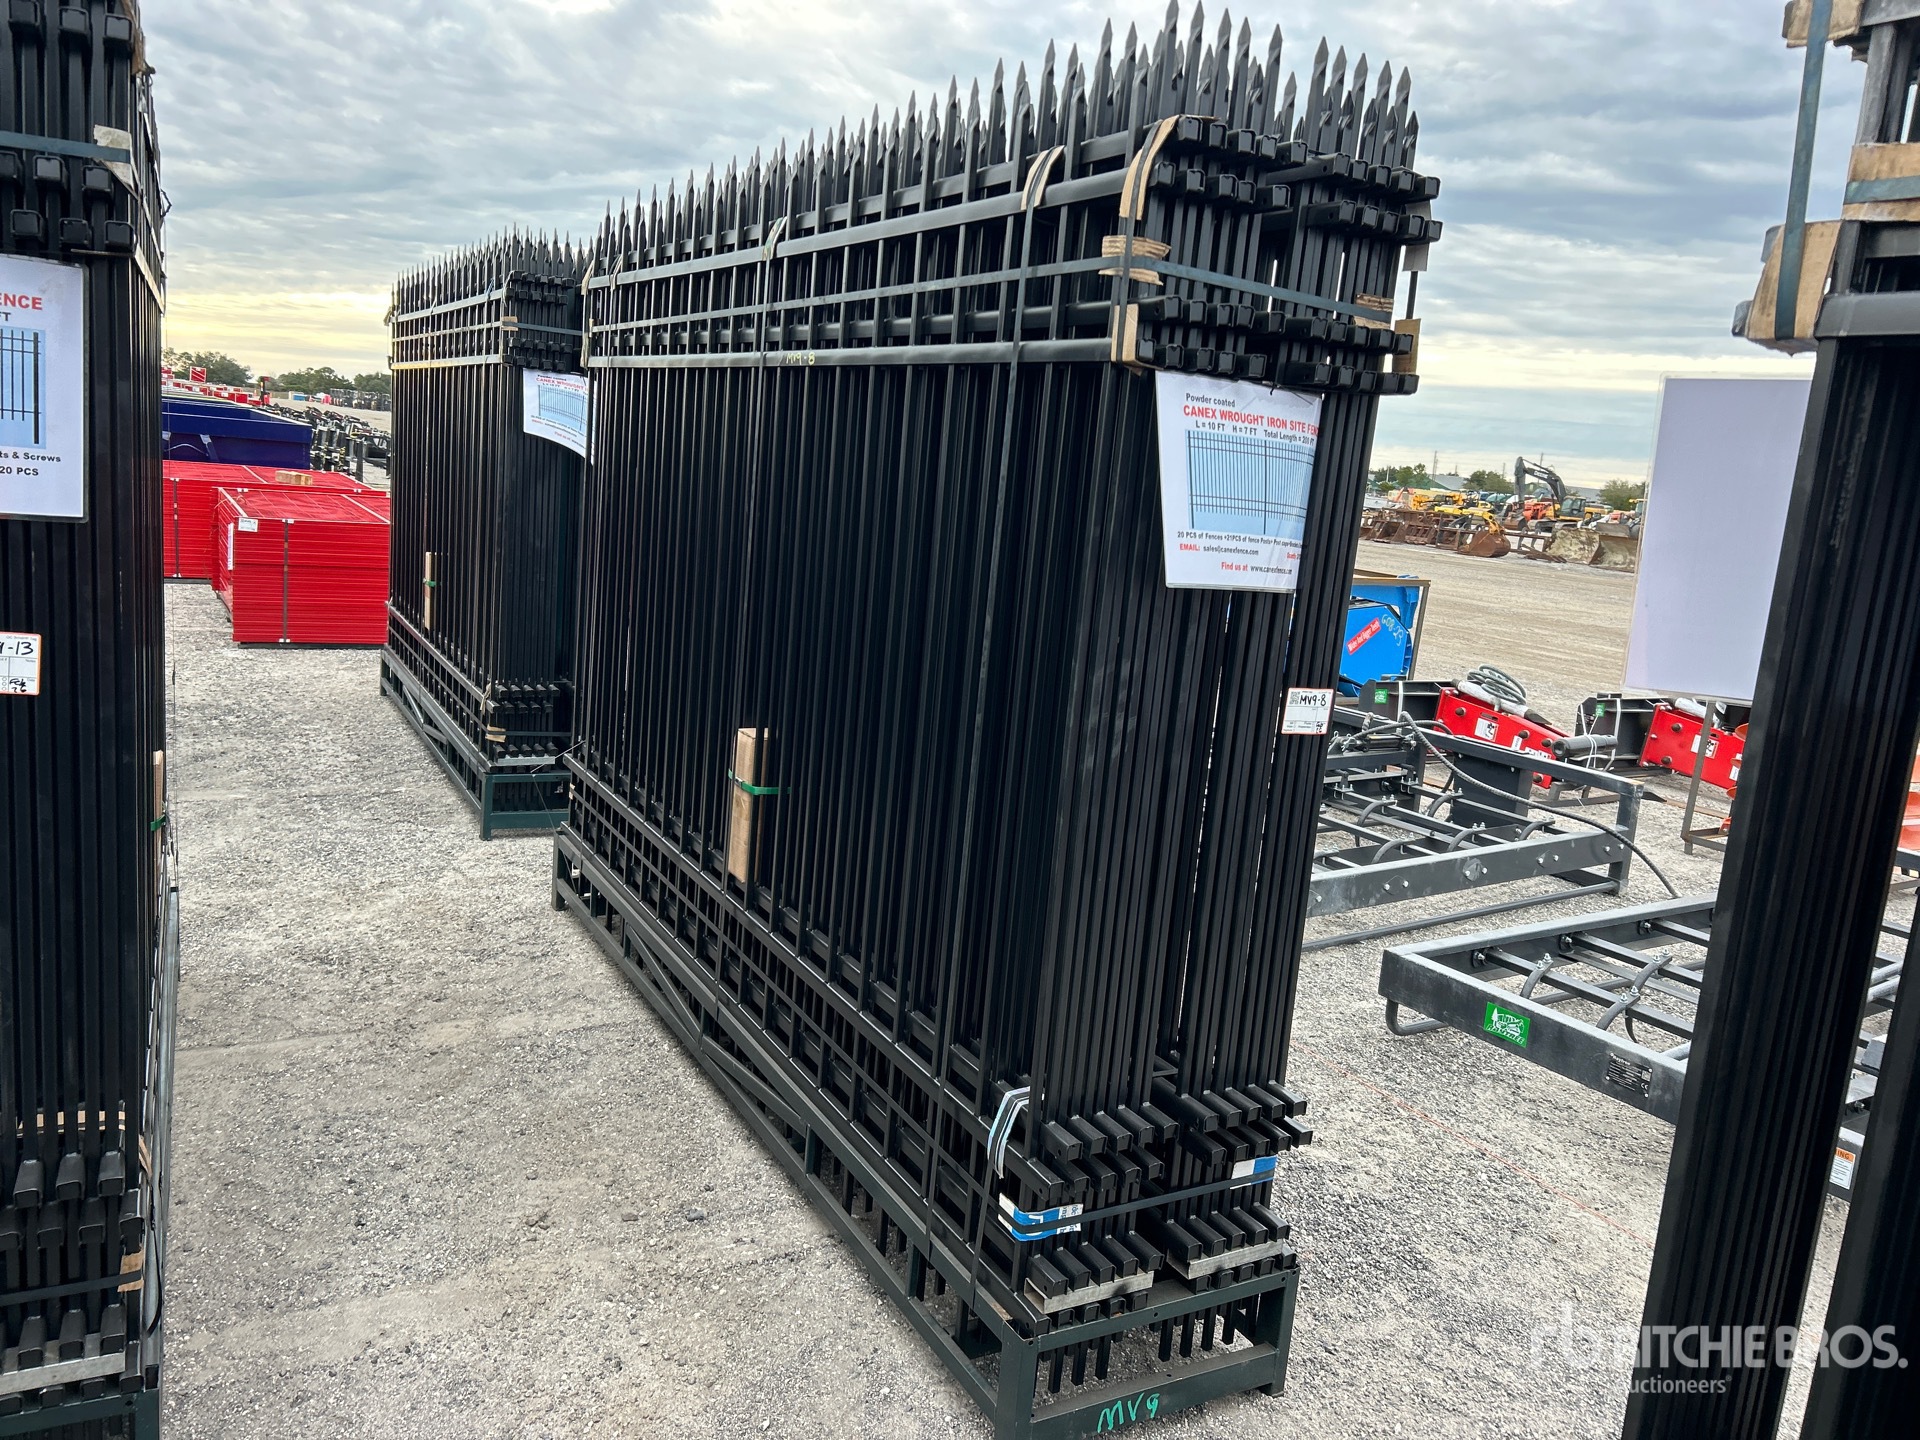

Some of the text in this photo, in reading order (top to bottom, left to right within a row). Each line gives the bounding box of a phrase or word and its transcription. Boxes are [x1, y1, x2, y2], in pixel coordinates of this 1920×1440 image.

[0, 293, 43, 310] NCE
[0, 311, 11, 321] T
[1186, 393, 1236, 407] Powder coated
[1183, 404, 1217, 420] CANEX
[1219, 409, 1264, 426] WROUGHT
[1267, 416, 1287, 430] IRON
[1290, 420, 1306, 434] SITE
[1195, 420, 1200, 429] L
[1208, 422, 1216, 430] 10
[1217, 423, 1225, 432] FT
[1232, 425, 1238, 433] H
[1250, 428, 1257, 436] FT
[1264, 429, 1278, 439] Total
[1280, 432, 1297, 443] Length
[12, 451, 19, 459] &
[23, 452, 61, 462] Screws
[17, 467, 39, 476] PCS
[1177, 531, 1184, 539] 20
[1186, 531, 1197, 539] PCS
[1205, 533, 1223, 541] Fences
[1180, 543, 1200, 551] EMAIL:
[1221, 561, 1233, 570] Find
[1299, 694, 1327, 706] MV9-8
[1097, 1392, 1160, 1433] MV9
